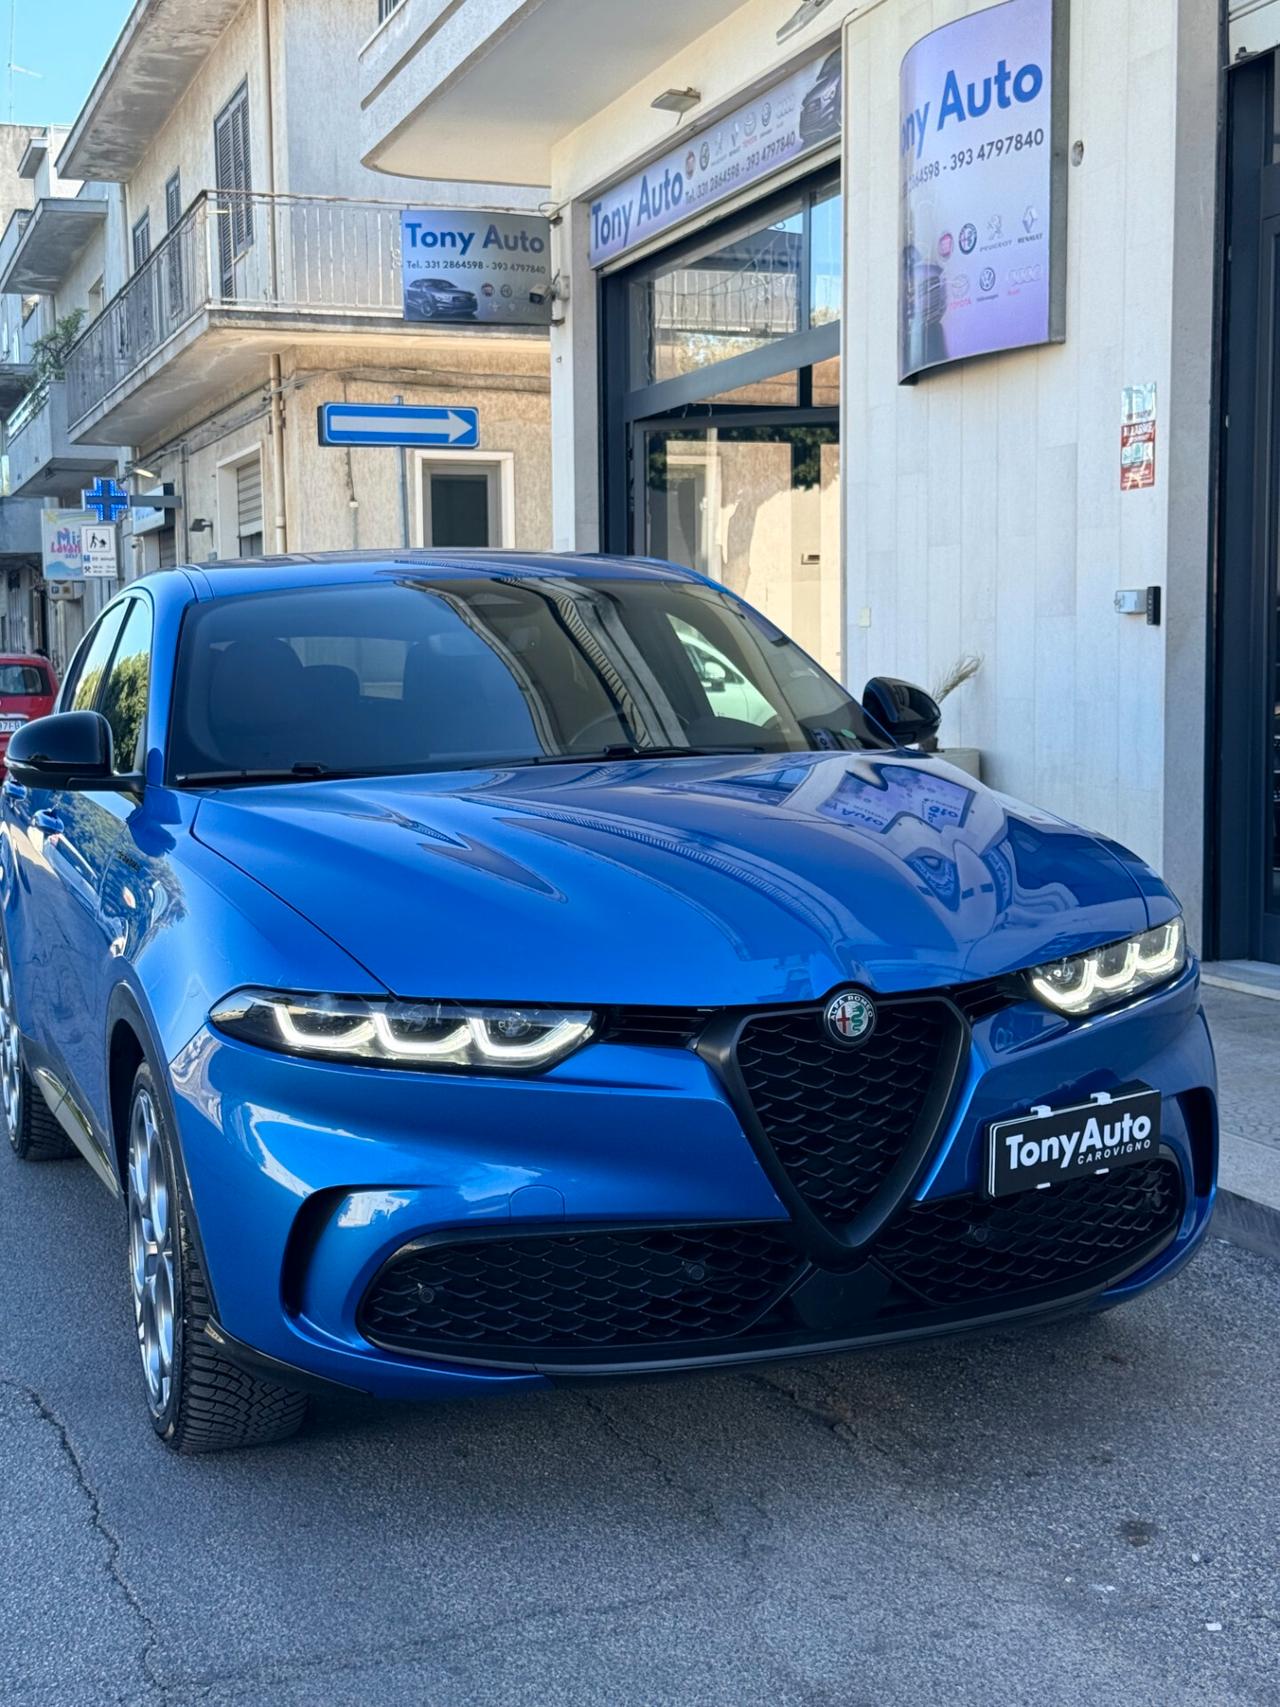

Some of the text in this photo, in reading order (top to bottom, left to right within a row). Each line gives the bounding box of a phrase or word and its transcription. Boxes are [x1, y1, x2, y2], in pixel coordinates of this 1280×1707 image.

[937, 60, 1043, 132] Auto
[950, 149, 973, 171] 393
[977, 128, 1044, 162] 4797840
[592, 168, 684, 250] Tony Auto
[405, 223, 545, 255] Tony Auto
[406, 260, 421, 269] Tel.
[425, 260, 440, 269] 331
[443, 260, 484, 270] 2864598
[491, 262, 508, 271] 393
[511, 264, 546, 274] 4797840
[50, 541, 81, 553] Lavan
[1006, 1112, 1152, 1170] TonyAuto
[1077, 1138, 1152, 1165] CAROVIGNO
